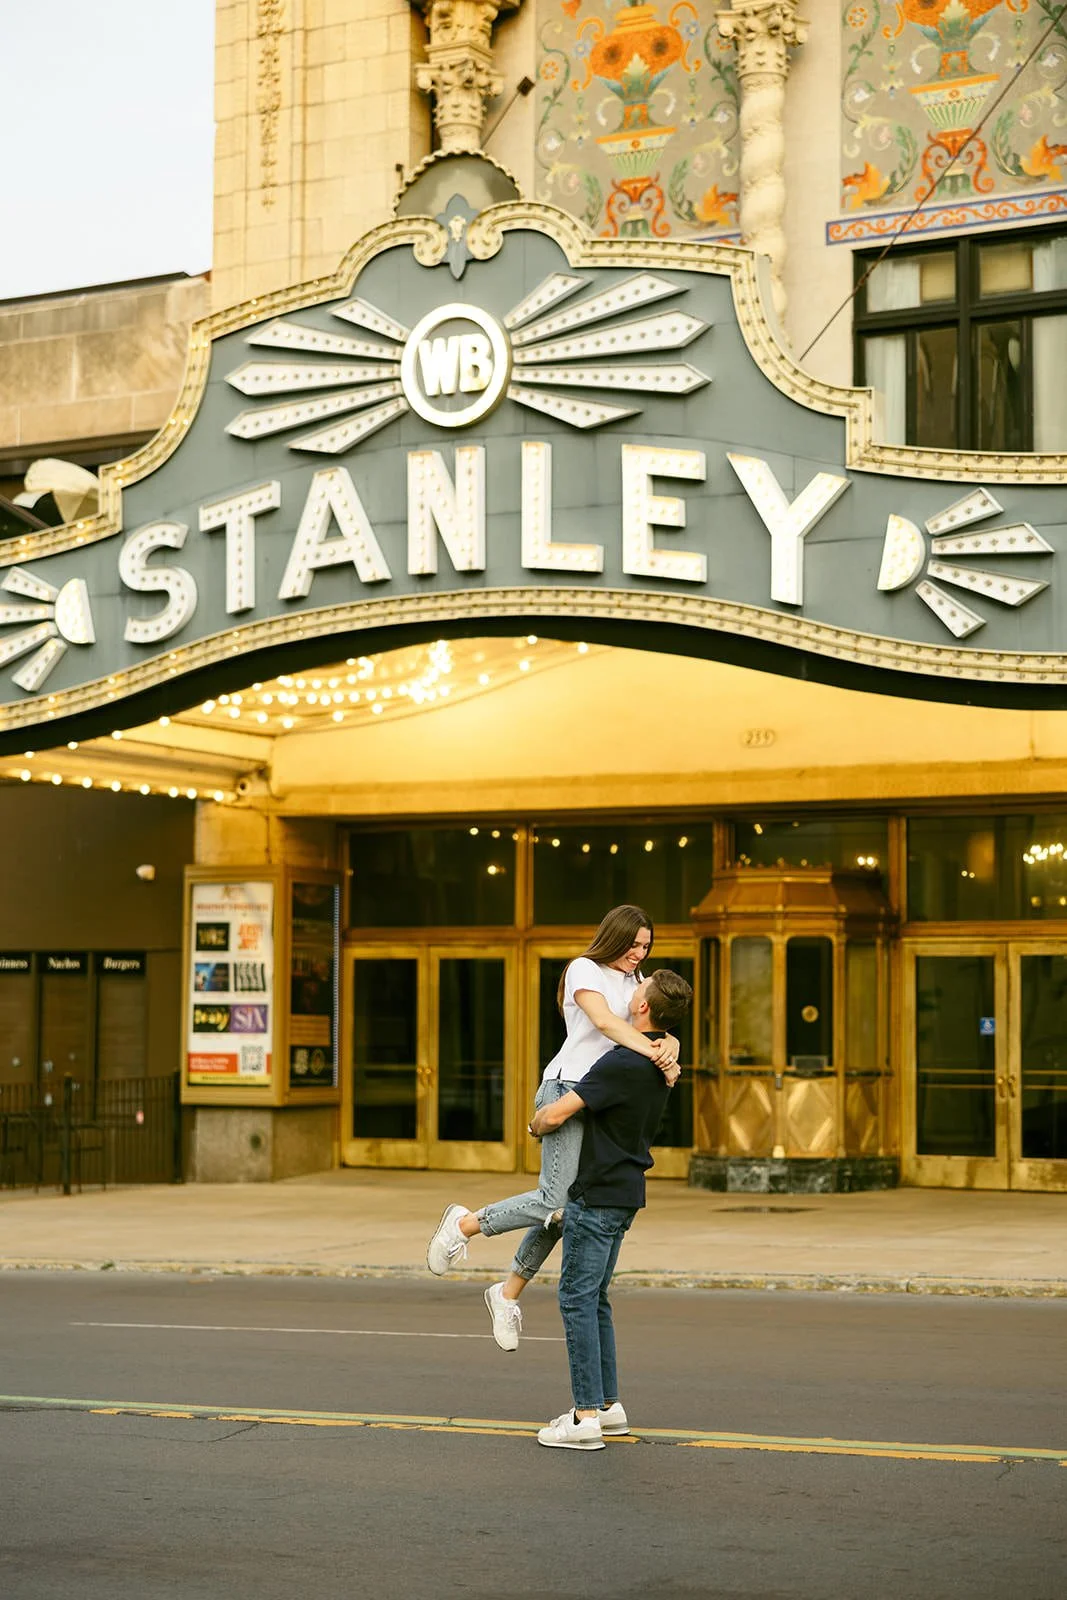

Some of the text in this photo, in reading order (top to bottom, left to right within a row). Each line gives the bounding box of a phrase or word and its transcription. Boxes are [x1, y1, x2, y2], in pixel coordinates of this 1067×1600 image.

[418, 333, 493, 397] WB
[118, 441, 852, 644] STANLEY
[48, 957, 81, 969] Nachos
[103, 956, 140, 971] Burgers
